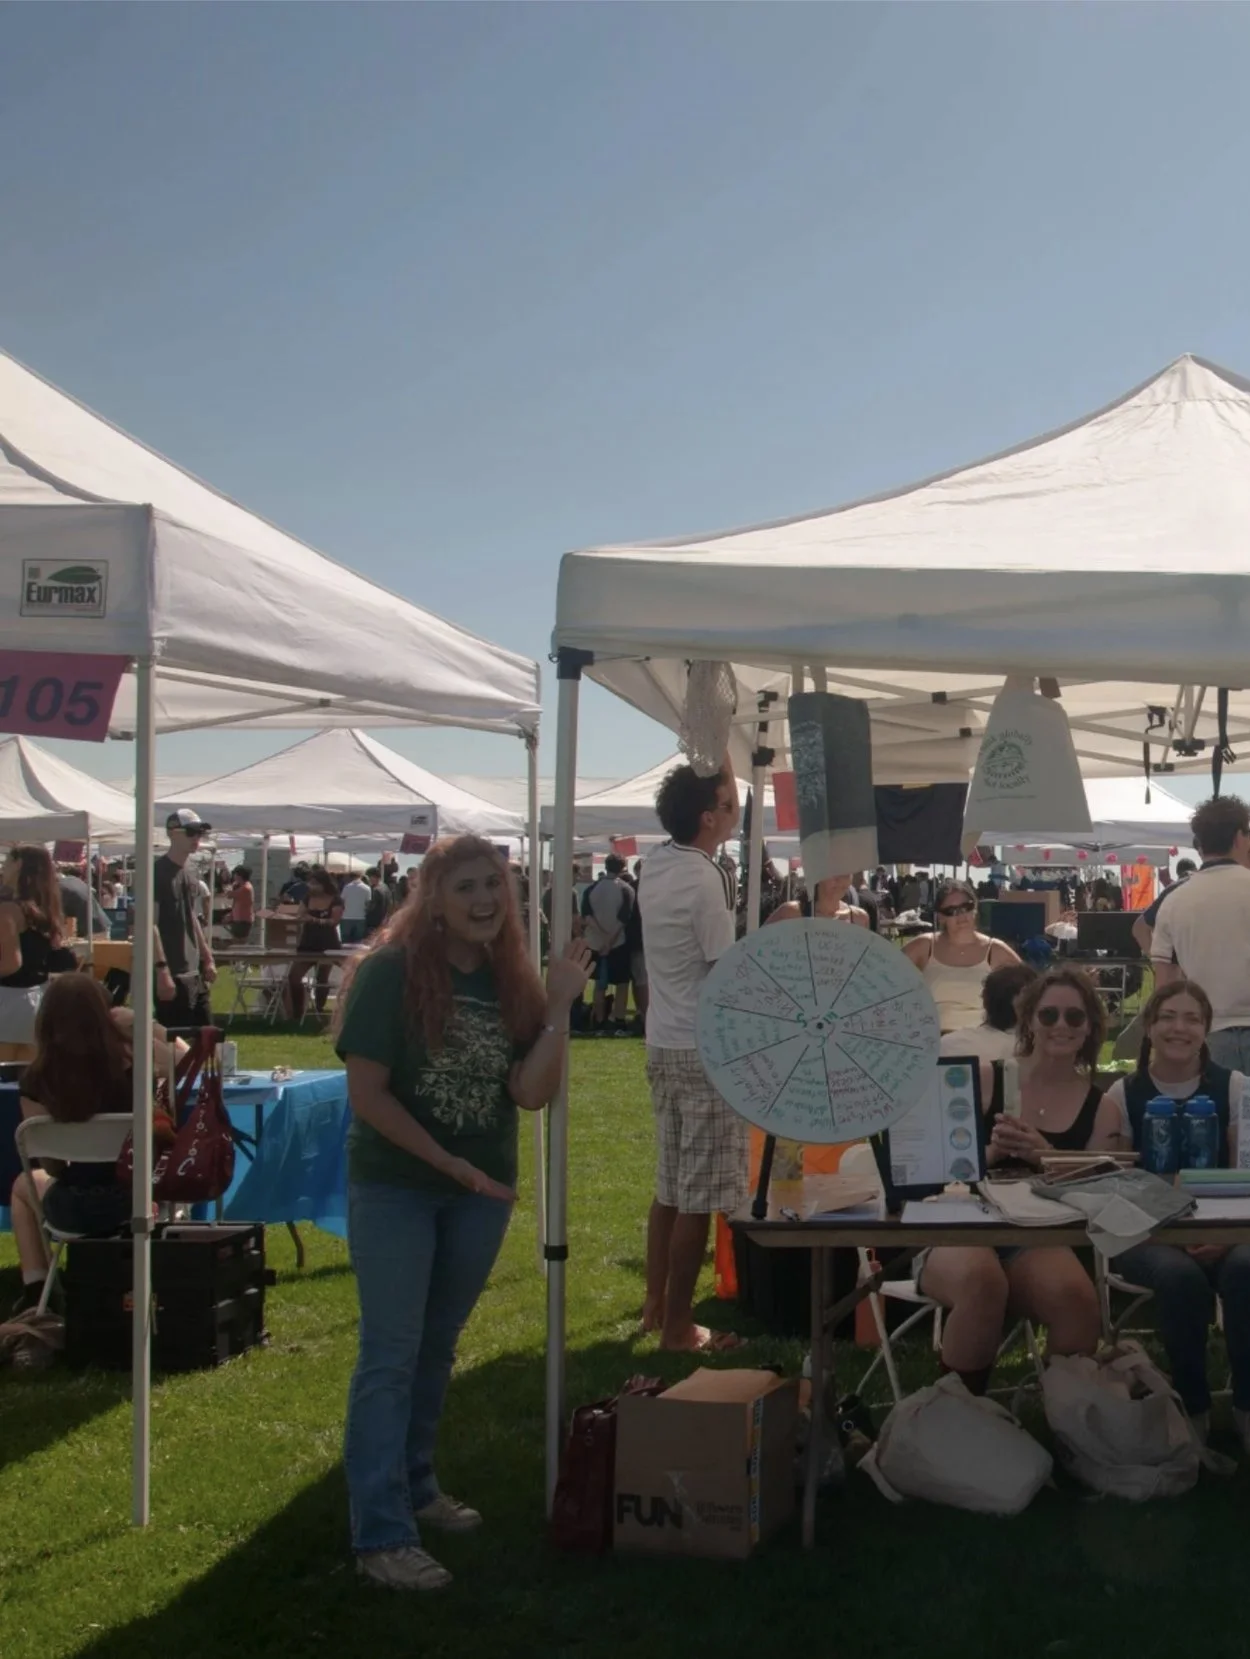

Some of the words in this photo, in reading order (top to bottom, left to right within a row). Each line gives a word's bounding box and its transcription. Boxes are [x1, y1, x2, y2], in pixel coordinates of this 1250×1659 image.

[26, 581, 98, 604] Eurmax
[0, 674, 104, 726] 105
[616, 1493, 683, 1530] FUN
